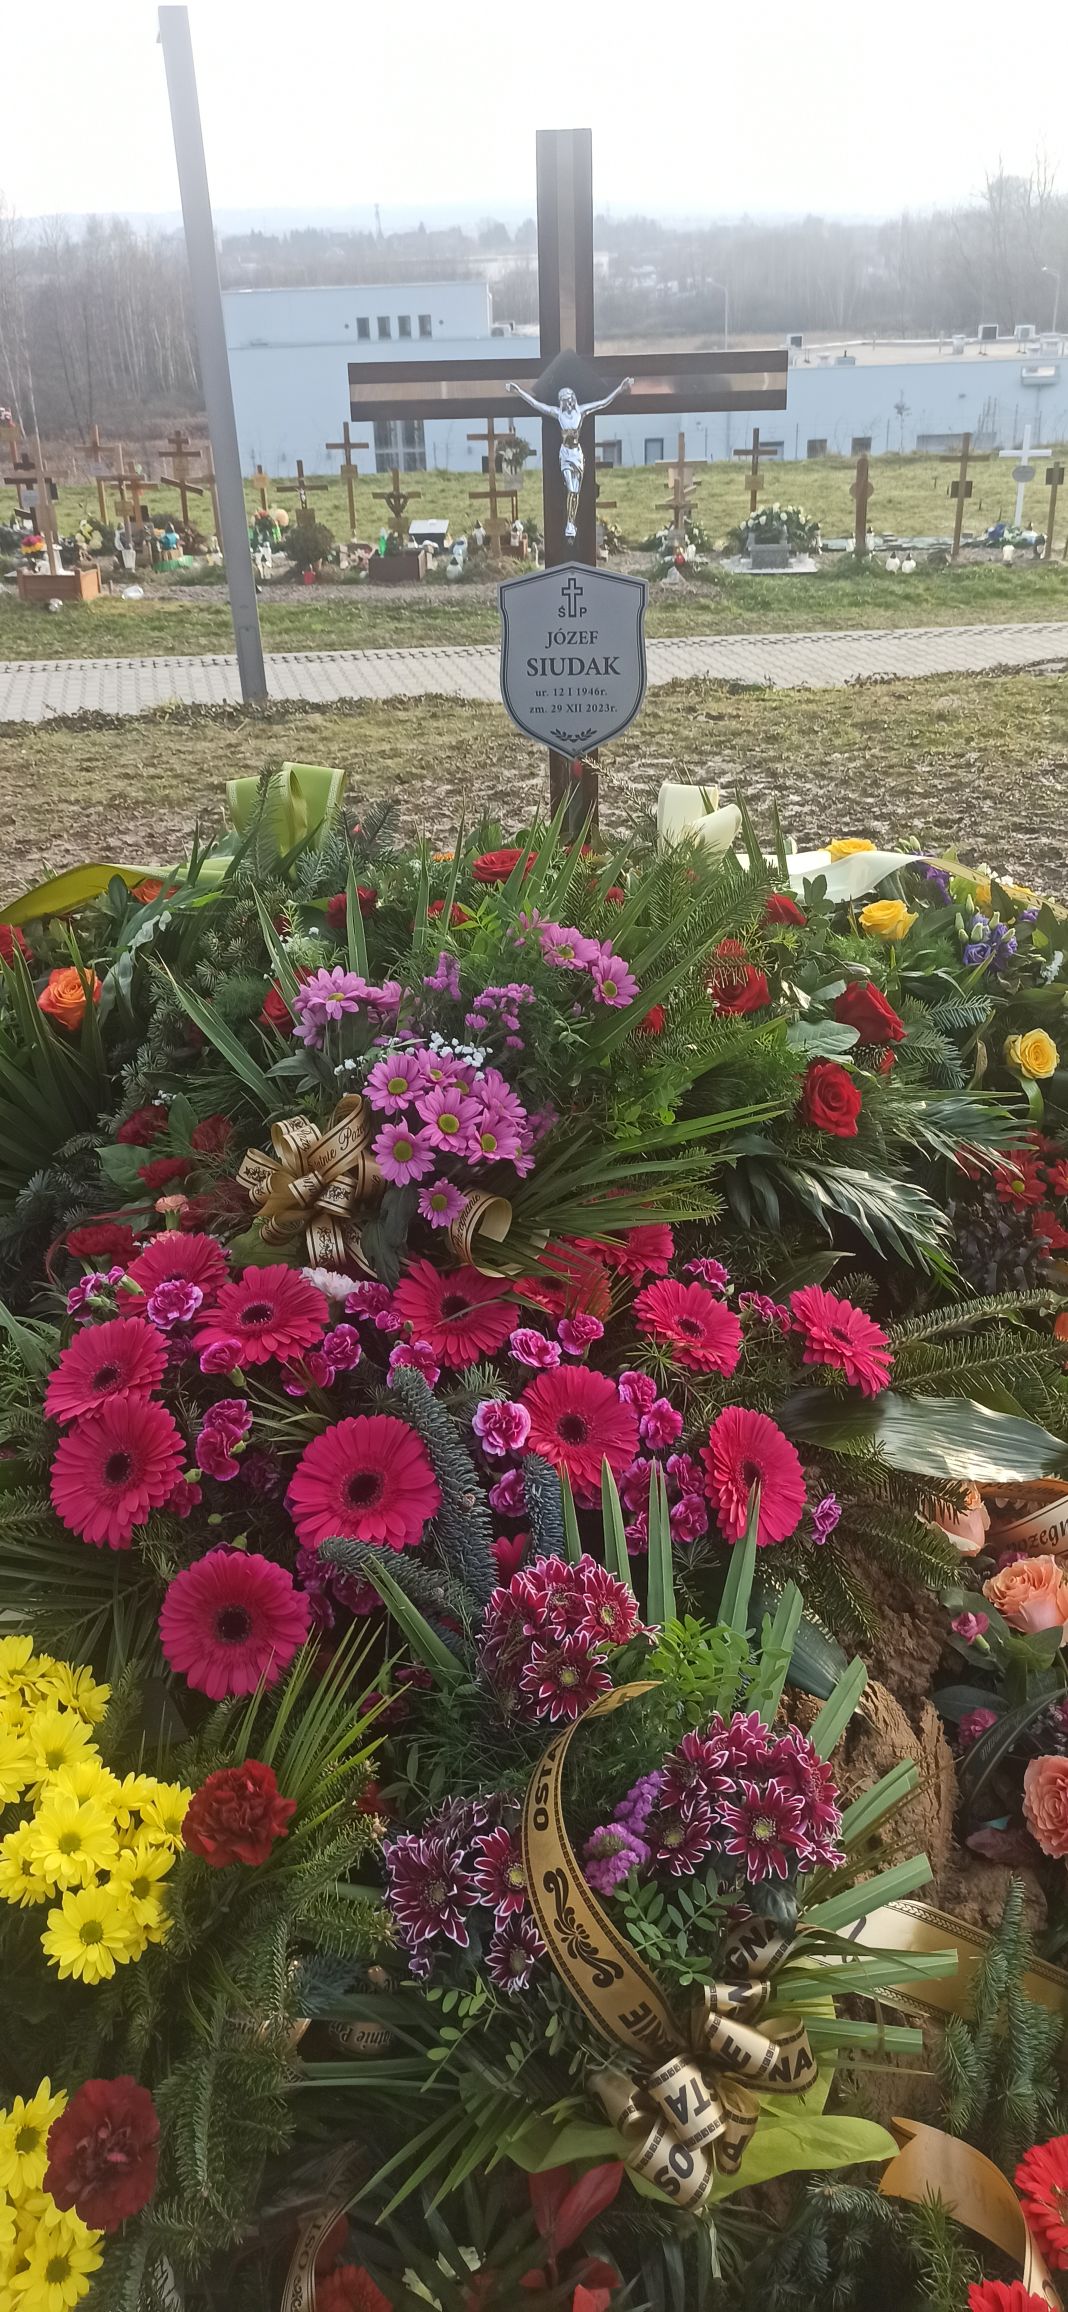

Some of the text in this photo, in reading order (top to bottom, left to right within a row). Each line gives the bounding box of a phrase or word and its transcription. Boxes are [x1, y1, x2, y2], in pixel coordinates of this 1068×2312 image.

[579, 607, 587, 618] P
[545, 628, 598, 649] JÓZEF
[526, 656, 621, 676] SIUDAK
[535, 689, 549, 697] ur.
[553, 688, 564, 697] 12
[576, 687, 608, 697] 1946r.
[529, 703, 618, 714] zm. 29 XII 2023r.
